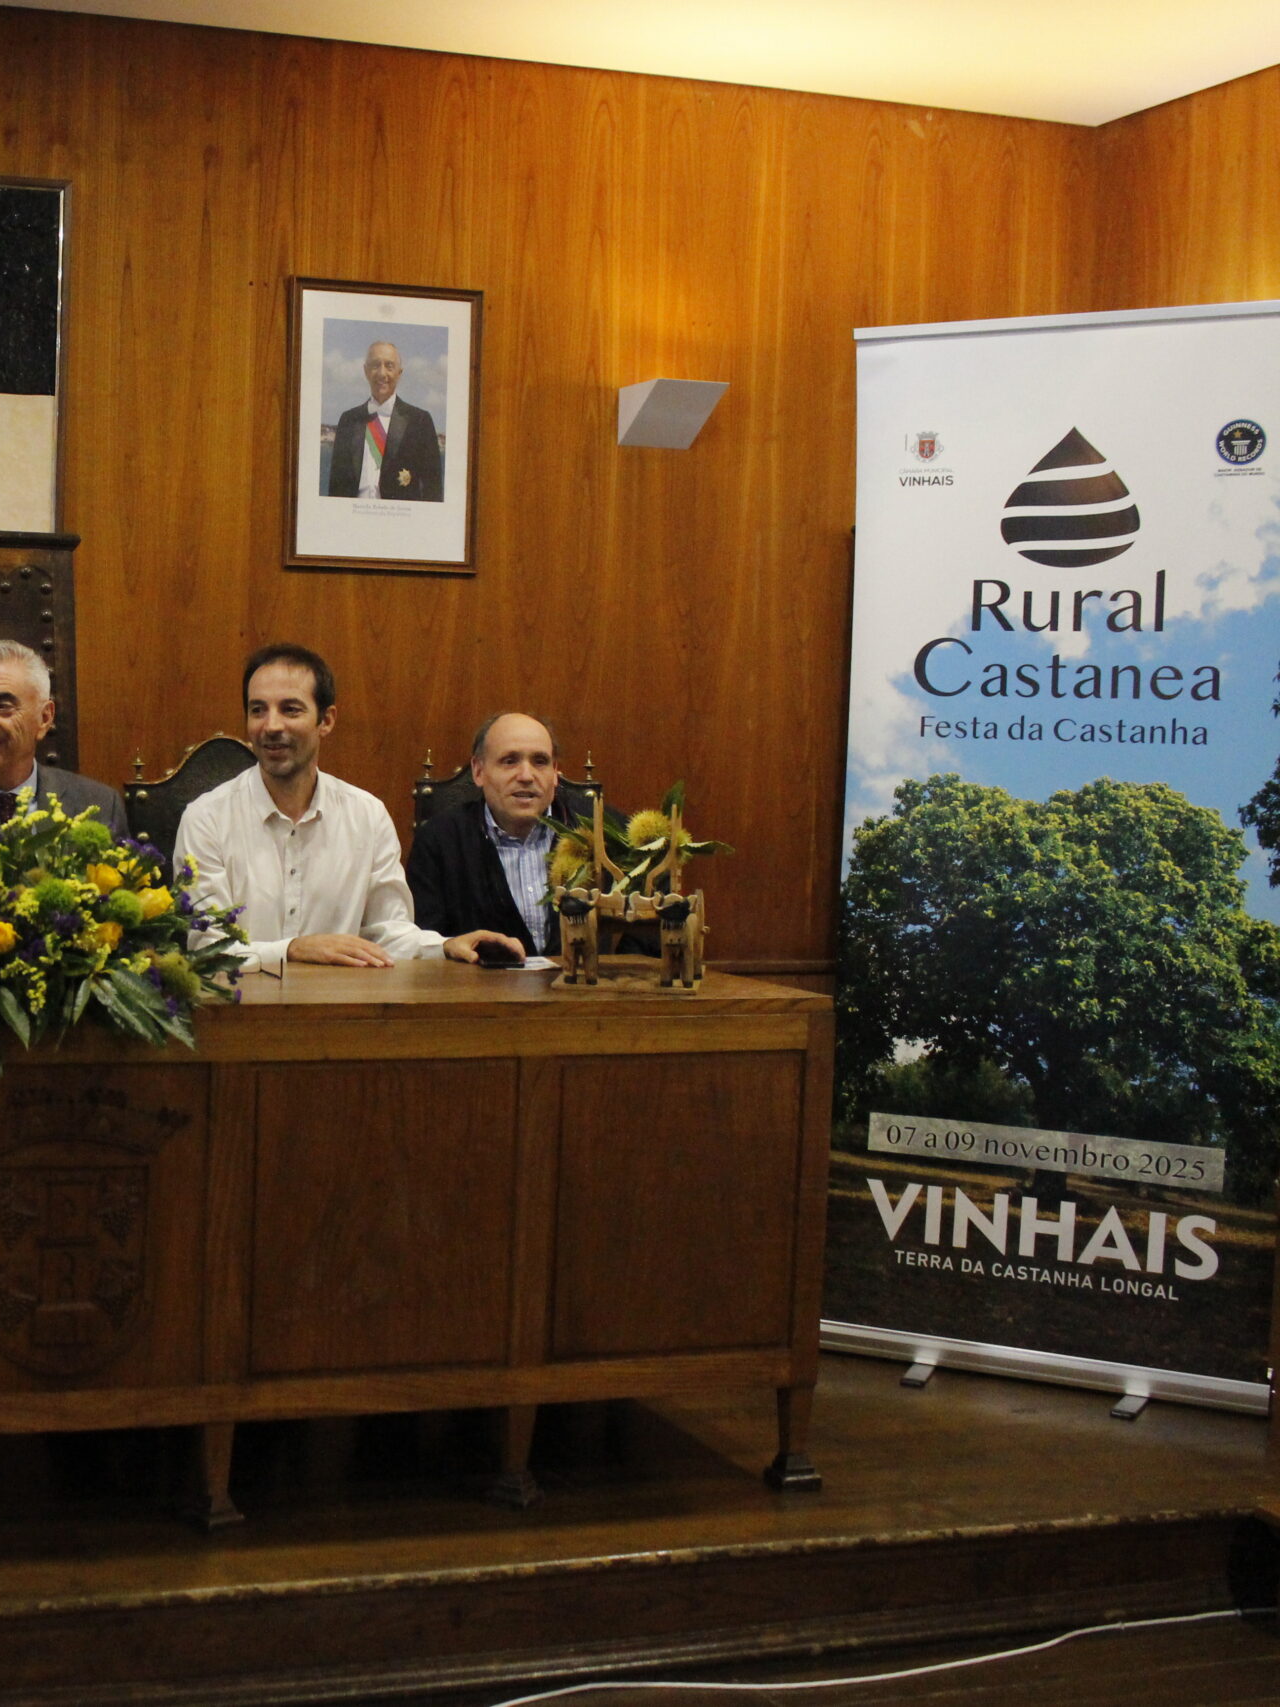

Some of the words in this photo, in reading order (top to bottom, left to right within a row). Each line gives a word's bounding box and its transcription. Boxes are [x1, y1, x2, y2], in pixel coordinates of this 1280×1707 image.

[898, 474, 954, 487] VINHAIS
[970, 568, 1166, 633] Rural
[913, 636, 1221, 701] Castanea
[919, 715, 998, 740] Festa
[1006, 714, 1043, 742] da
[1053, 717, 1209, 746] Castanha
[886, 1124, 917, 1146] 07
[924, 1132, 937, 1149] a
[944, 1130, 976, 1151] 09
[984, 1137, 1131, 1171] novembro
[1137, 1152, 1206, 1181] 2025
[866, 1178, 1220, 1281] VINHAIS
[894, 1249, 955, 1272] TERRA
[960, 1259, 985, 1276] DA
[991, 1262, 1094, 1290] CASTANHA
[1100, 1276, 1180, 1301] LONGAL
